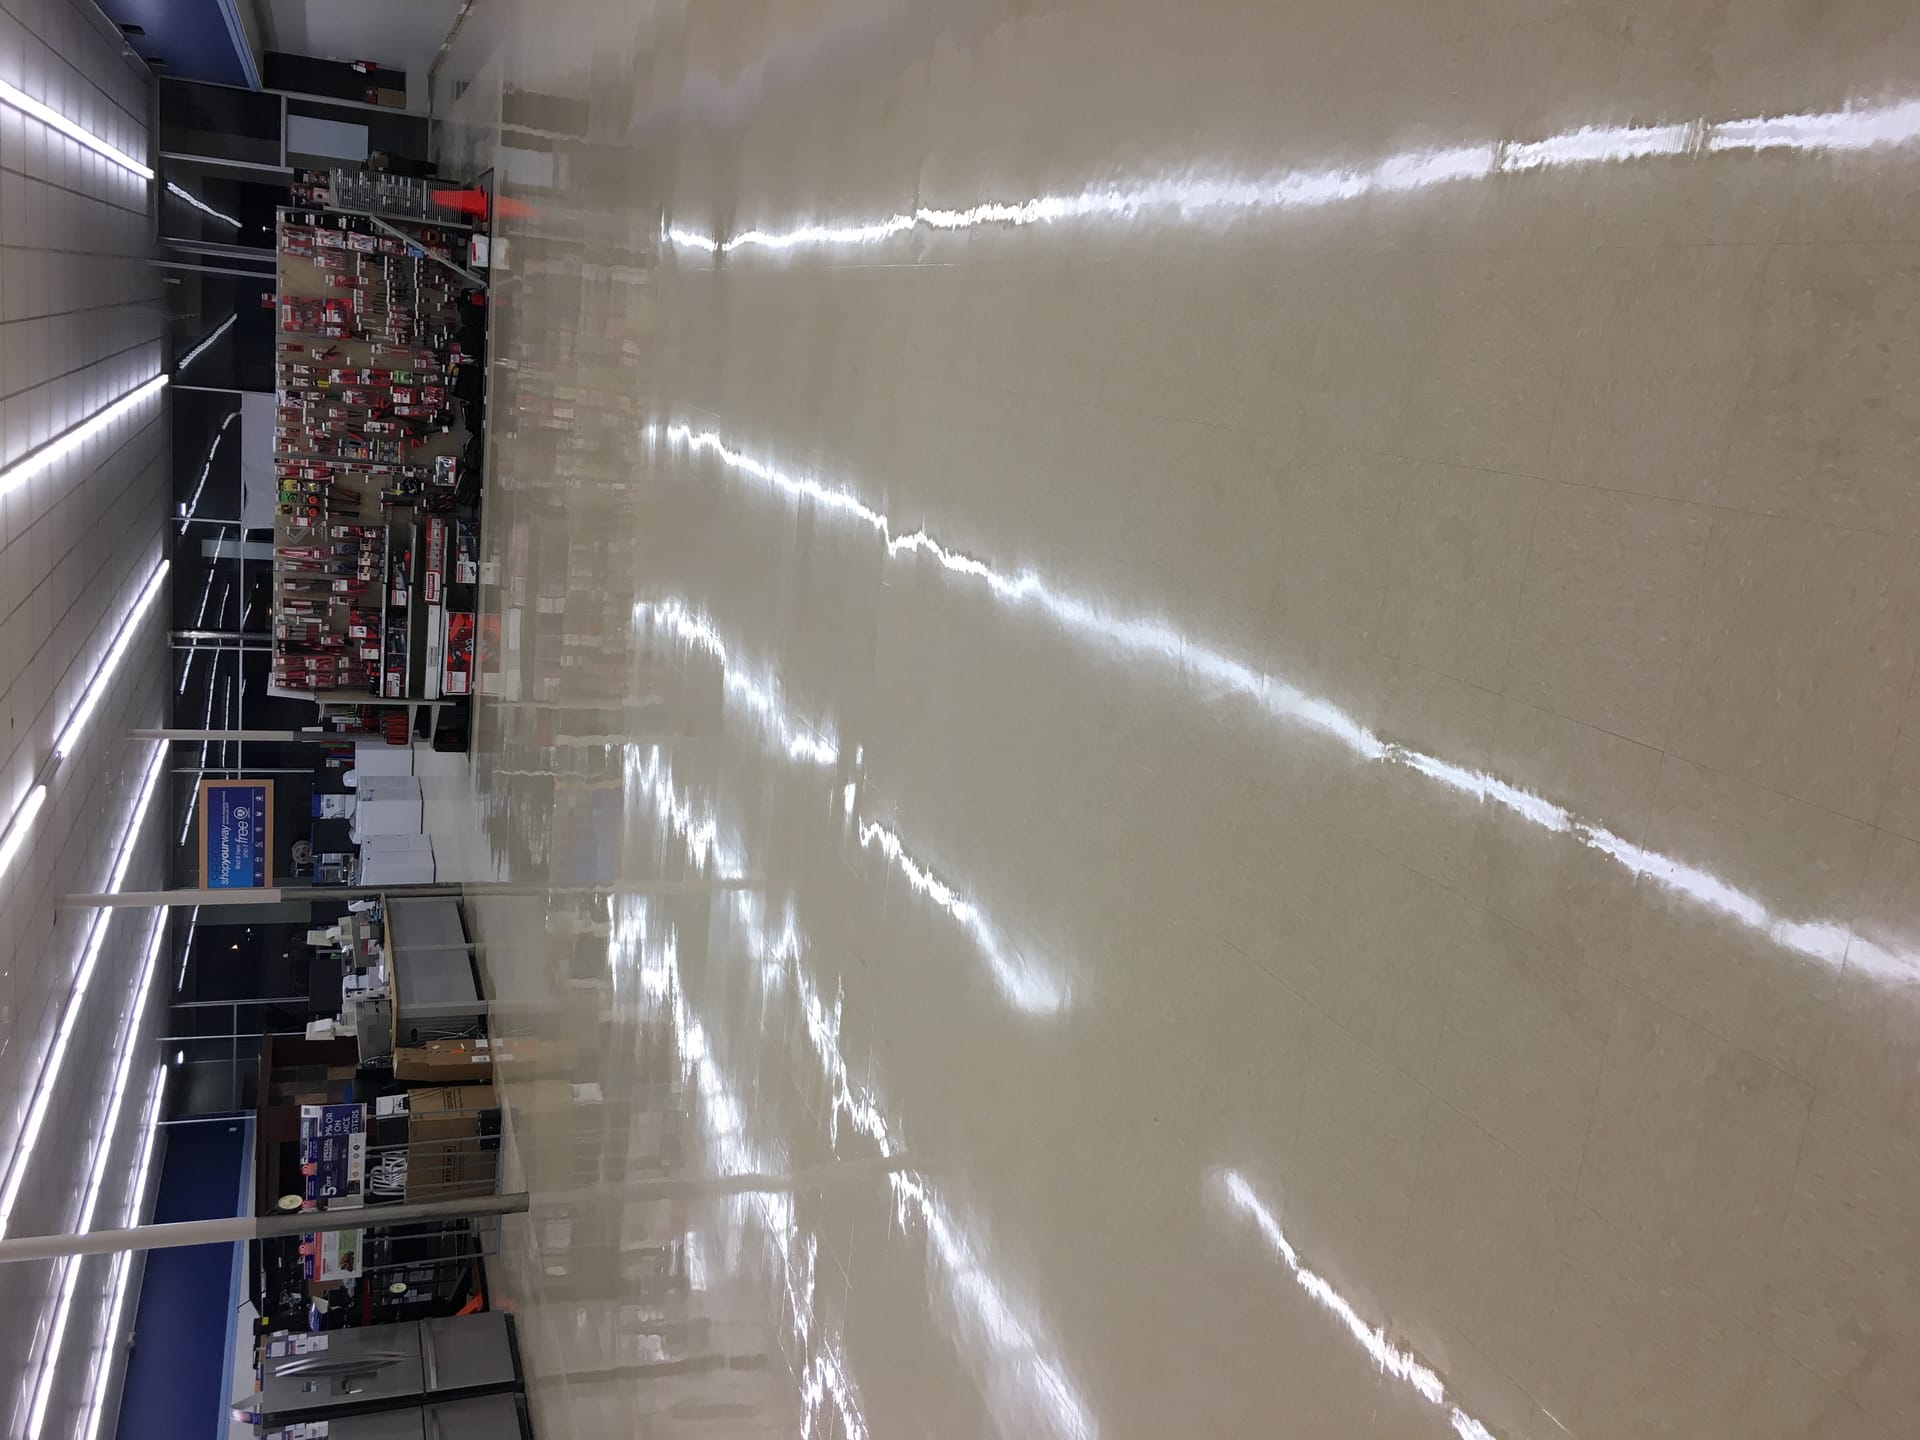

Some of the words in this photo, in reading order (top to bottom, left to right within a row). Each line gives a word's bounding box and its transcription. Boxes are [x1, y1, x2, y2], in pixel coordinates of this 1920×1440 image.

[235, 821, 248, 843] free
[221, 825, 231, 885] shopyourway
[326, 1112, 333, 1123] OR
[334, 1120, 342, 1132] ON
